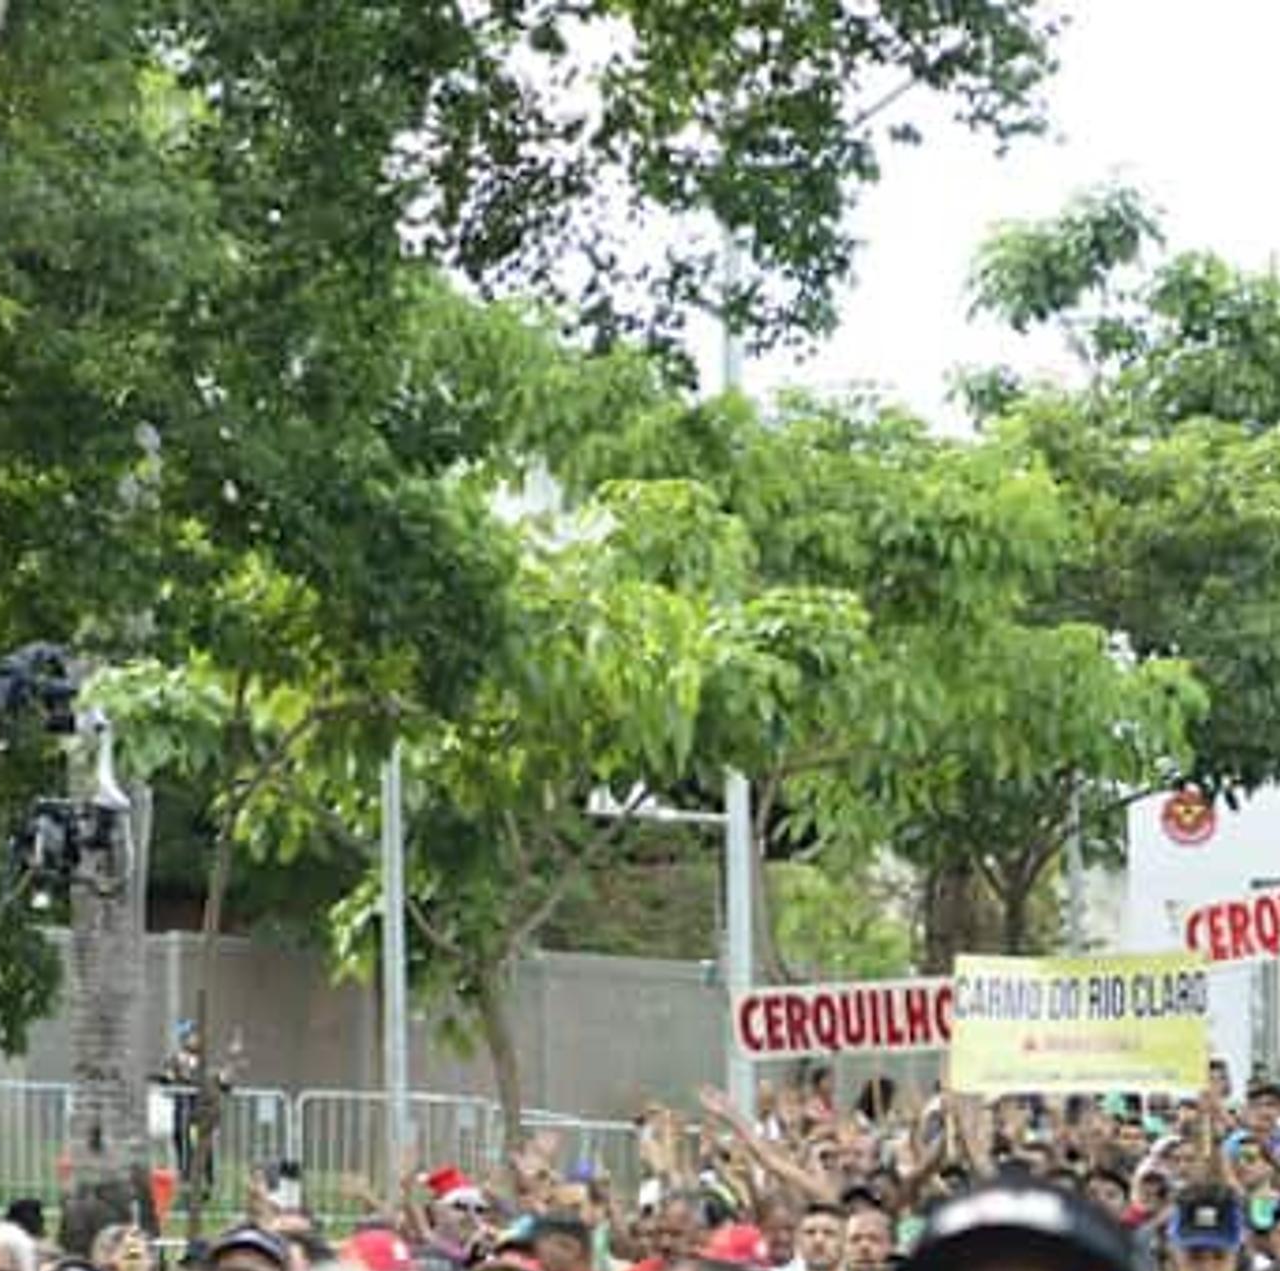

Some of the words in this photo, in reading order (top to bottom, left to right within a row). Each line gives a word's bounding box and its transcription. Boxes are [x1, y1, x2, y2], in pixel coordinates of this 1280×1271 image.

[956, 975, 1040, 1019] CARMO
[1087, 976, 1123, 1020] RIO
[1131, 971, 1207, 1018] CLARO
